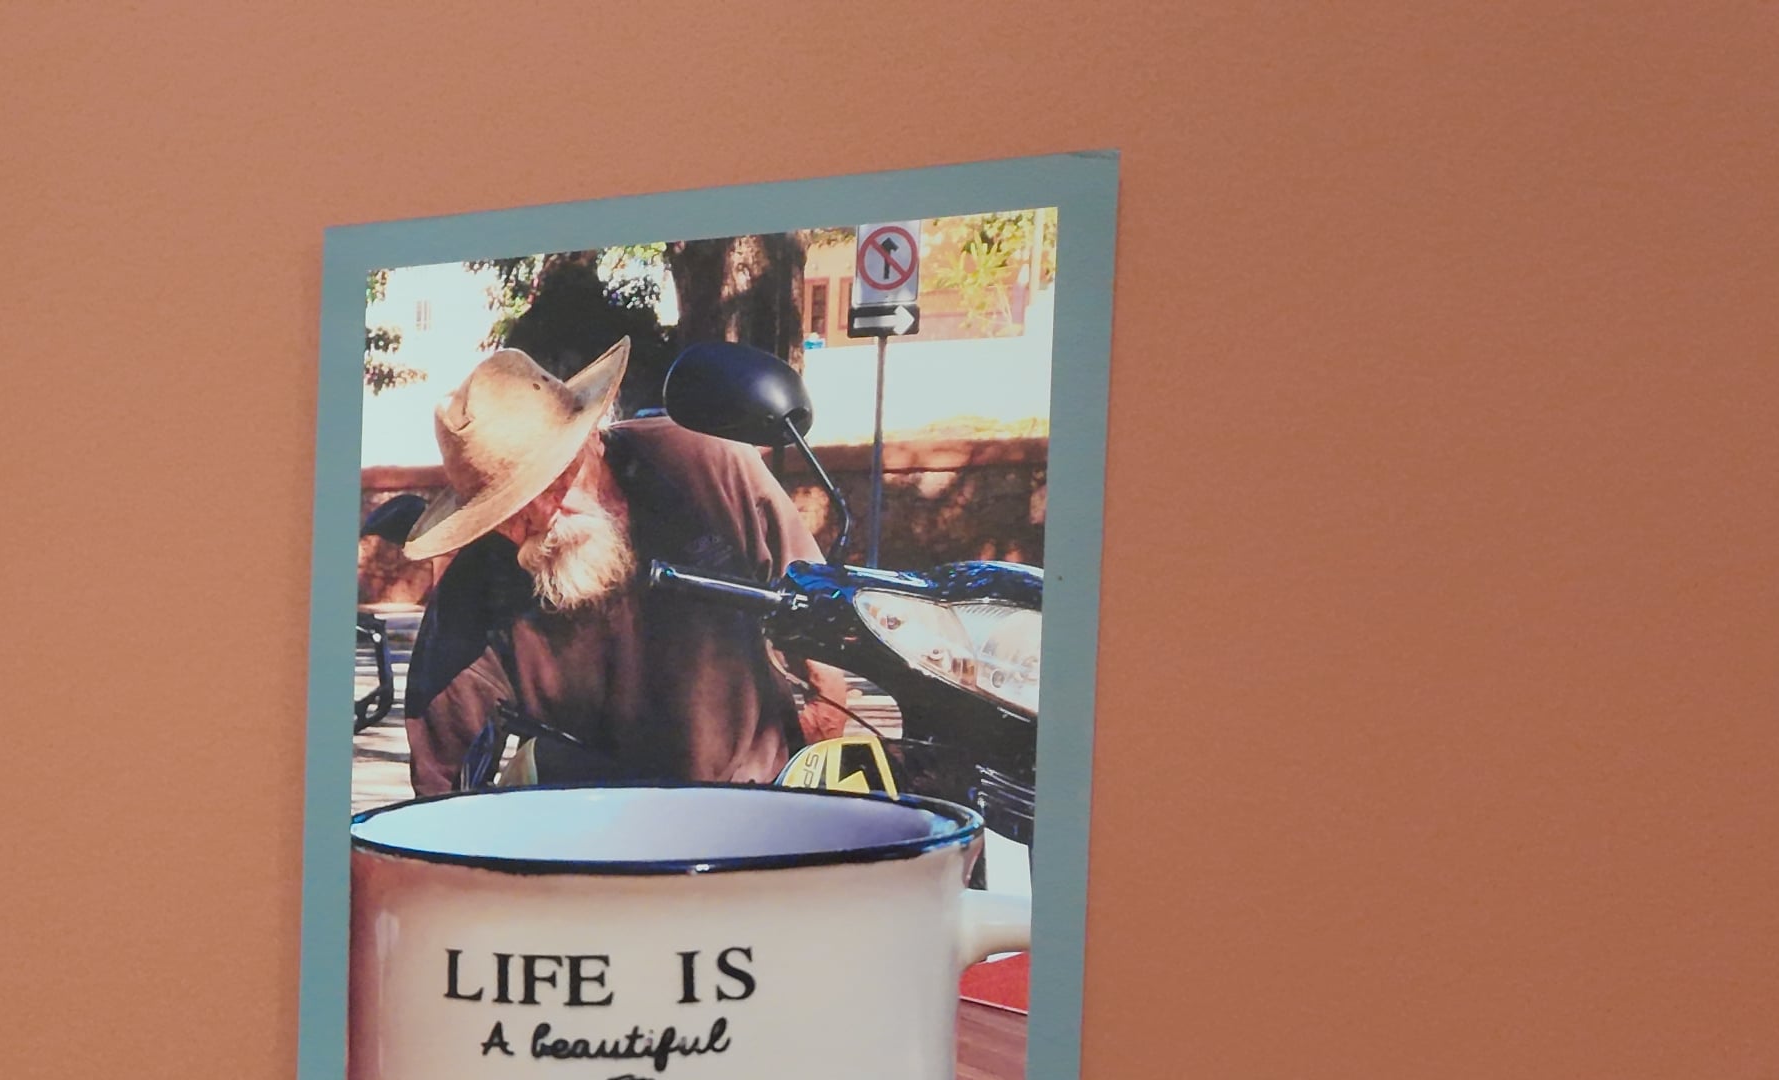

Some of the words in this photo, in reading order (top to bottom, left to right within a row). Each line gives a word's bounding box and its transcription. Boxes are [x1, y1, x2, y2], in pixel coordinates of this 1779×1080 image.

[443, 948, 614, 1007] LIFE
[676, 946, 757, 1004] IS
[481, 1020, 515, 1056] A
[530, 1017, 731, 1072] beautiful
